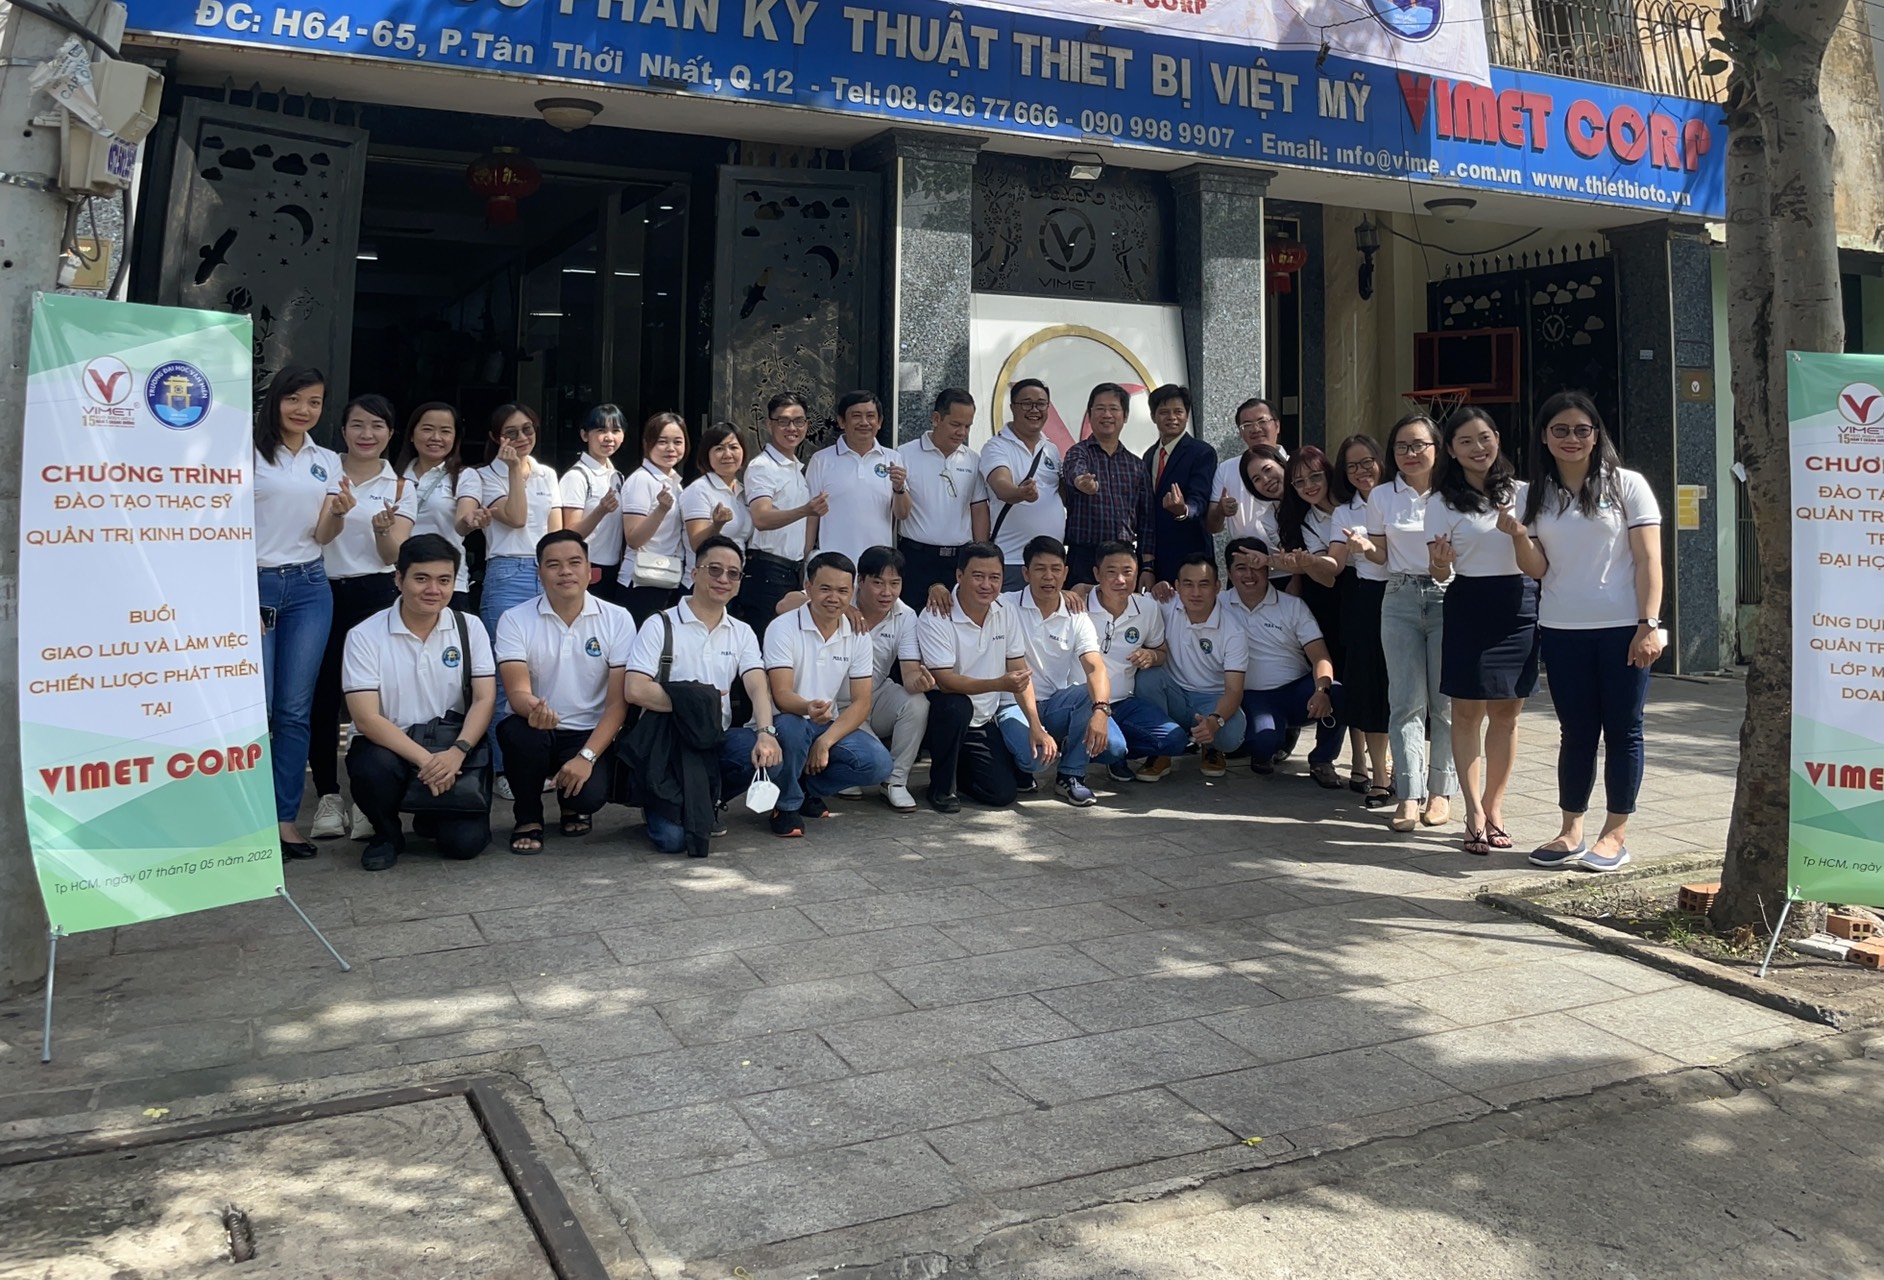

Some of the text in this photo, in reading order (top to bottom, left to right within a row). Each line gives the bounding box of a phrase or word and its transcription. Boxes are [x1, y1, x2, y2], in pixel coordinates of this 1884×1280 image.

[843, 10, 999, 78] THUẬT
[1152, 53, 1192, 109] BỊ
[1211, 58, 1300, 121] VIỆT
[1318, 73, 1373, 124] MỸ
[272, 7, 428, 59] H64-65,
[438, 25, 535, 66] P.Tân
[552, 41, 623, 75] Thới
[640, 53, 722, 93] Nhất,
[729, 64, 795, 96] Q.12
[1080, 108, 1124, 136] 090
[1129, 116, 1173, 142] 998
[1178, 122, 1236, 150] 9907
[1262, 134, 1330, 164] Email:
[1531, 171, 1692, 208] www.thietbioto.vn
[1397, 72, 1713, 173] VIMET CORP
[1037, 277, 1097, 291] VIMET
[82, 406, 135, 417] VIMET
[82, 414, 96, 427] 15
[1838, 433, 1850, 444] 15
[41, 461, 243, 485] CHƯƠNG TRÌNH
[1805, 455, 1884, 474] CHƯƠ
[1818, 483, 1862, 500] ĐÀO
[53, 493, 233, 512] ĐÀO TẠO THẠC SỸ
[1796, 504, 1854, 522] QUẢN
[26, 525, 252, 546] QUẢN TRỊ KINH DOANH
[1818, 552, 1852, 569] ĐẠI
[129, 604, 176, 624] BUỔI
[1812, 612, 1884, 633] ỨNG DỤ
[41, 632, 249, 662] GIAO LƯU VÀ LÀM VIỆC
[1810, 637, 1862, 653] QUẢN
[29, 658, 259, 695] CHIẾN LƯỢC PHÁT TRIỂN
[1830, 661, 1867, 677] LỚP
[1842, 687, 1884, 702] DOA
[141, 701, 172, 719] TẠI
[39, 741, 263, 797] VIMET CORP
[54, 883, 68, 896] Tp
[104, 872, 136, 889] ngày
[138, 869, 153, 882] 07
[199, 858, 215, 870] 05
[217, 855, 245, 868] năm
[247, 848, 274, 862] 2022
[1803, 856, 1883, 874] Tp HCM, ngày
